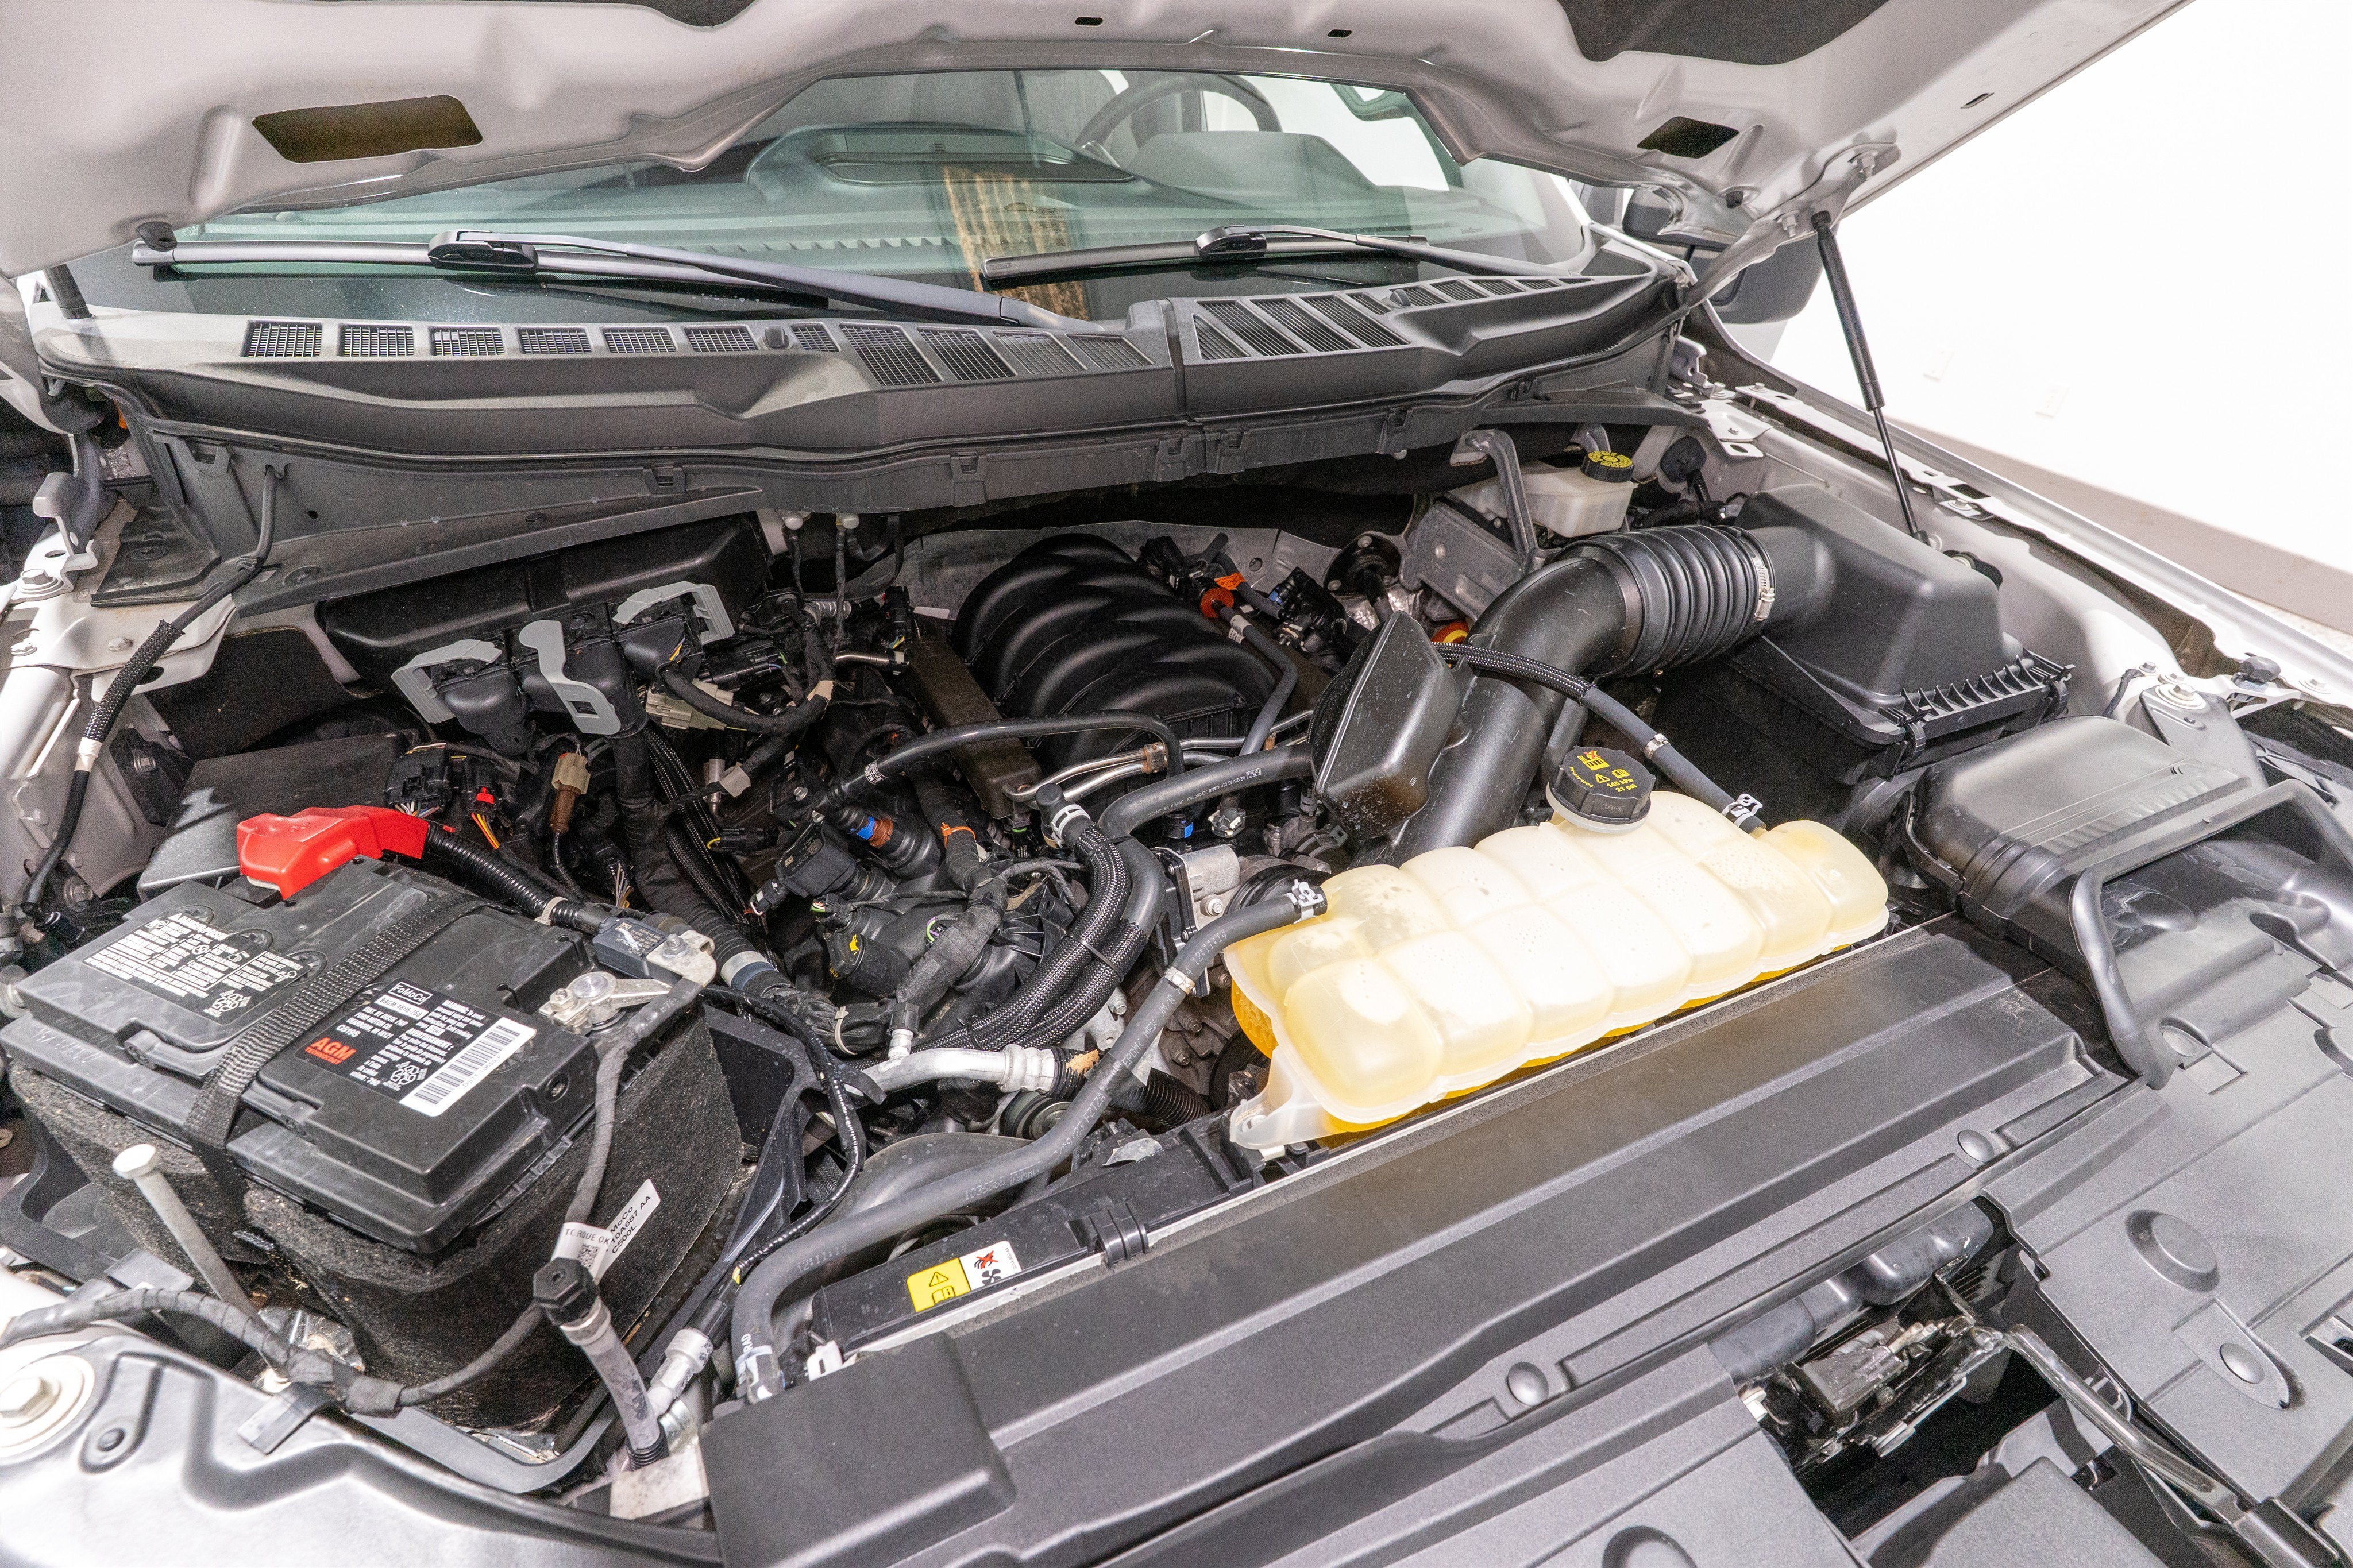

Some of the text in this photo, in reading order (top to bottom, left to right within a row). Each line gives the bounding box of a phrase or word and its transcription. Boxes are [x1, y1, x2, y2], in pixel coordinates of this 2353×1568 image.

[391, 985, 429, 1002] FoMoCo
[345, 1018, 375, 1031] DEARBORN,
[366, 1017, 386, 1026] MOTOR
[335, 1024, 361, 1037] G519S
[309, 1036, 358, 1060] AGM
[610, 1206, 634, 1234] MoCo
[611, 1195, 651, 1243] 10A687 AA
[599, 1235, 611, 1245] OK
[612, 1225, 637, 1254] C500L
